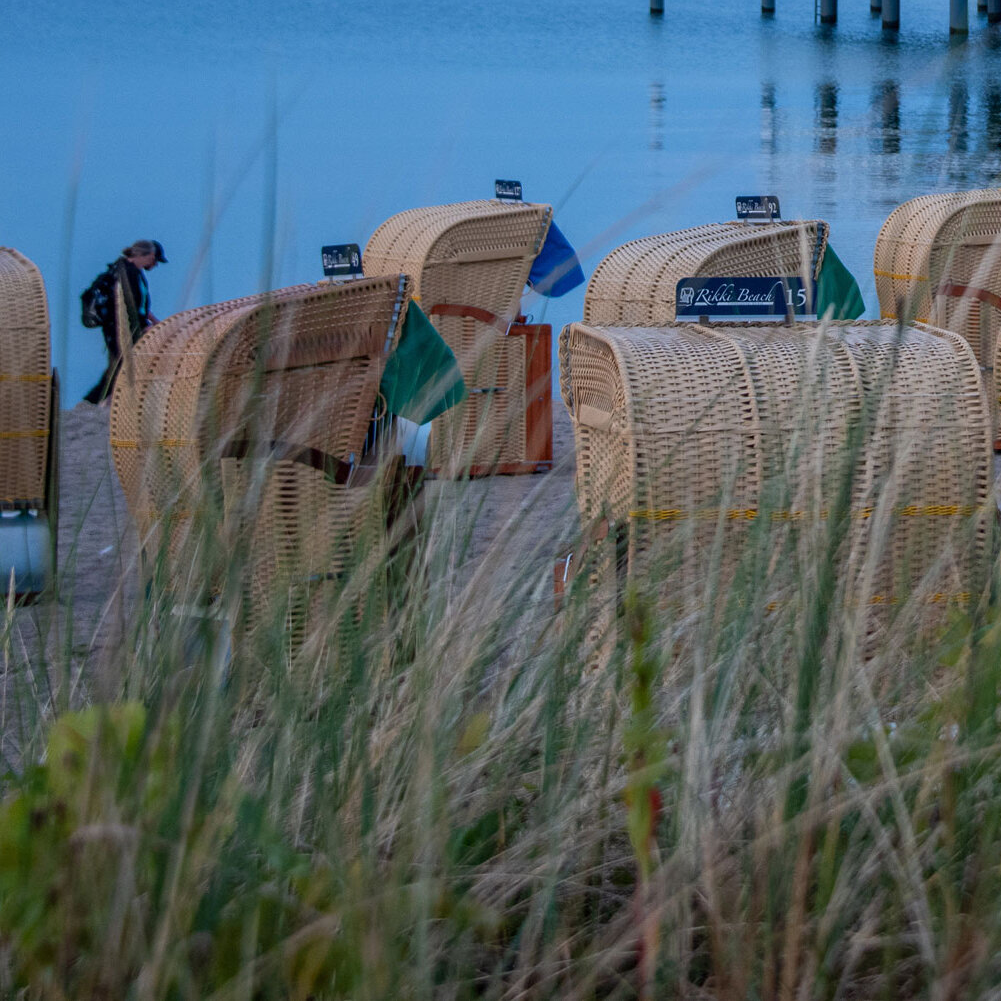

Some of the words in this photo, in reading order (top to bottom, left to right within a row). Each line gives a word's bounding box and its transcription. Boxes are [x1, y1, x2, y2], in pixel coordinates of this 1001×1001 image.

[768, 202, 777, 214] 92
[695, 283, 735, 306] Rikki
[737, 280, 783, 302] Beach
[785, 288, 807, 307] 15
